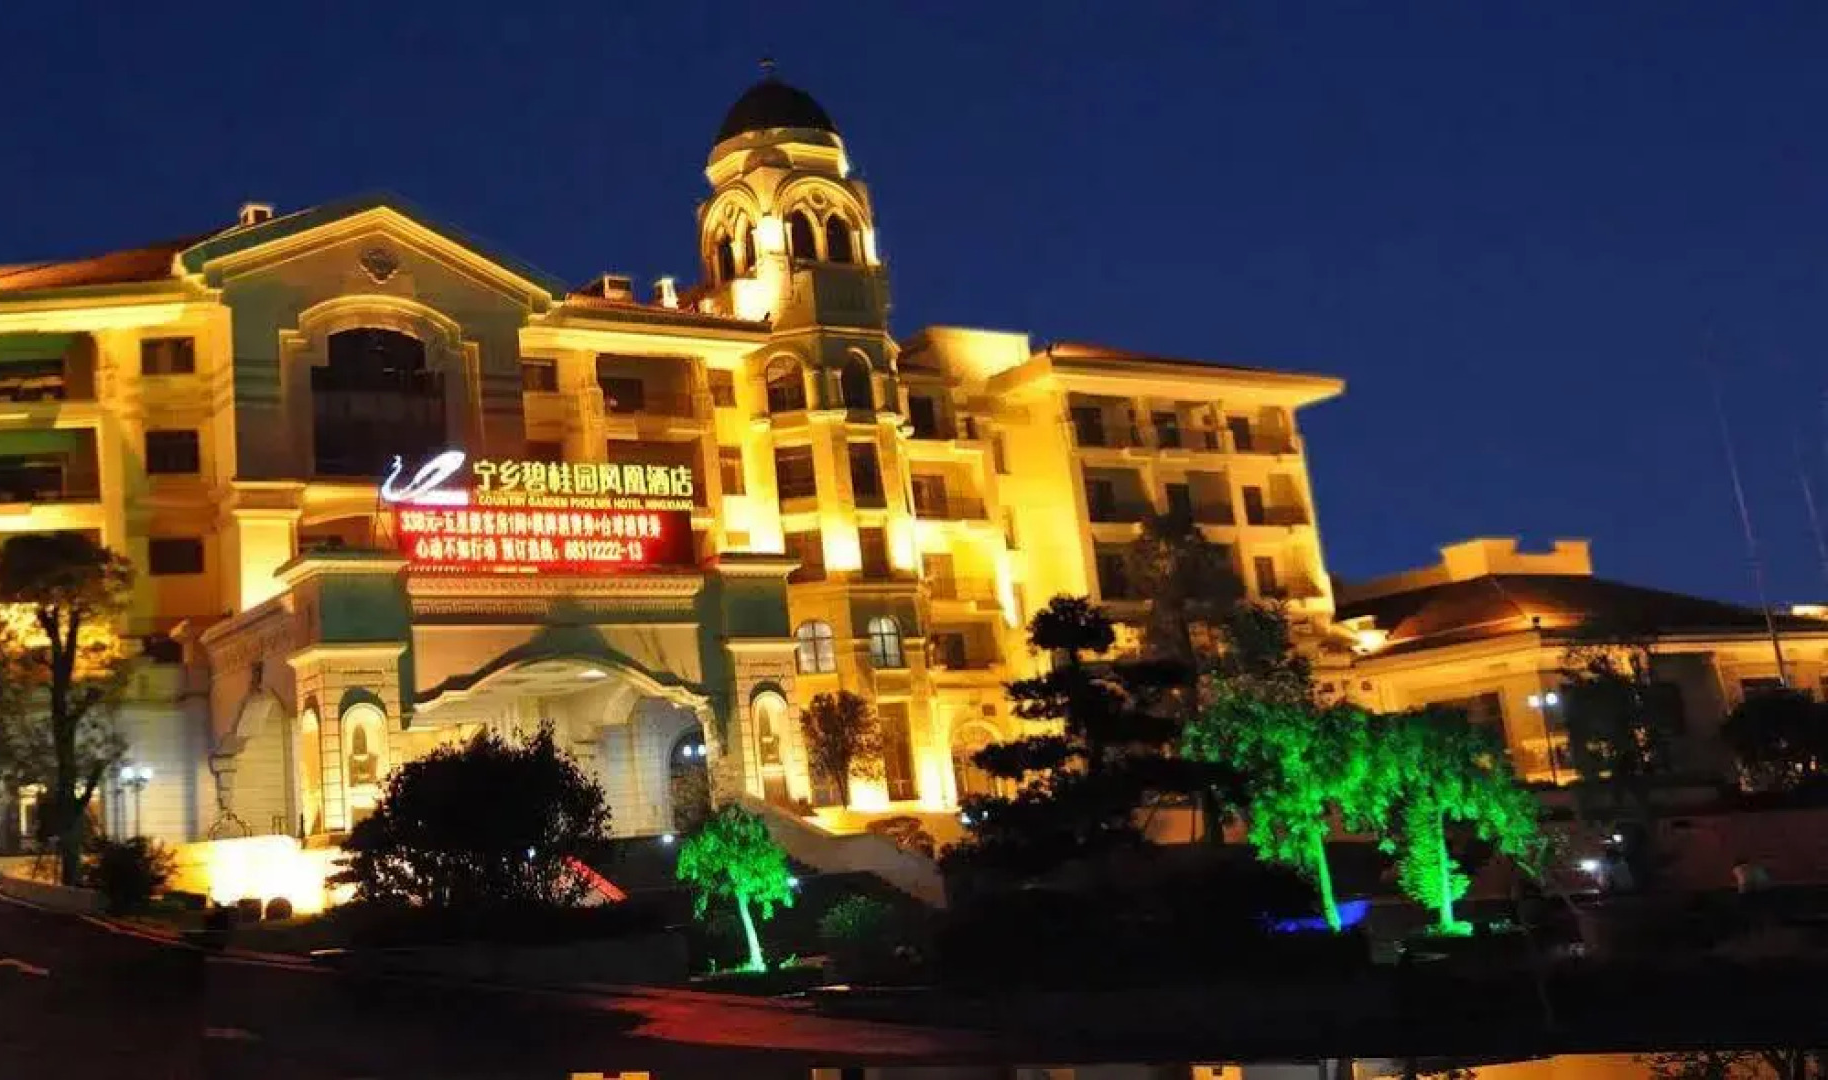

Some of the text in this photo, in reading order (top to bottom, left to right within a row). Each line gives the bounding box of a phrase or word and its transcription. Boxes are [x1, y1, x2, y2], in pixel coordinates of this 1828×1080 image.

[473, 460, 693, 496] 宁乡碧桂园凤凰酒店
[478, 495, 525, 506] COUNTRY
[529, 496, 568, 507] GARDEN
[614, 499, 644, 509] HOTEL
